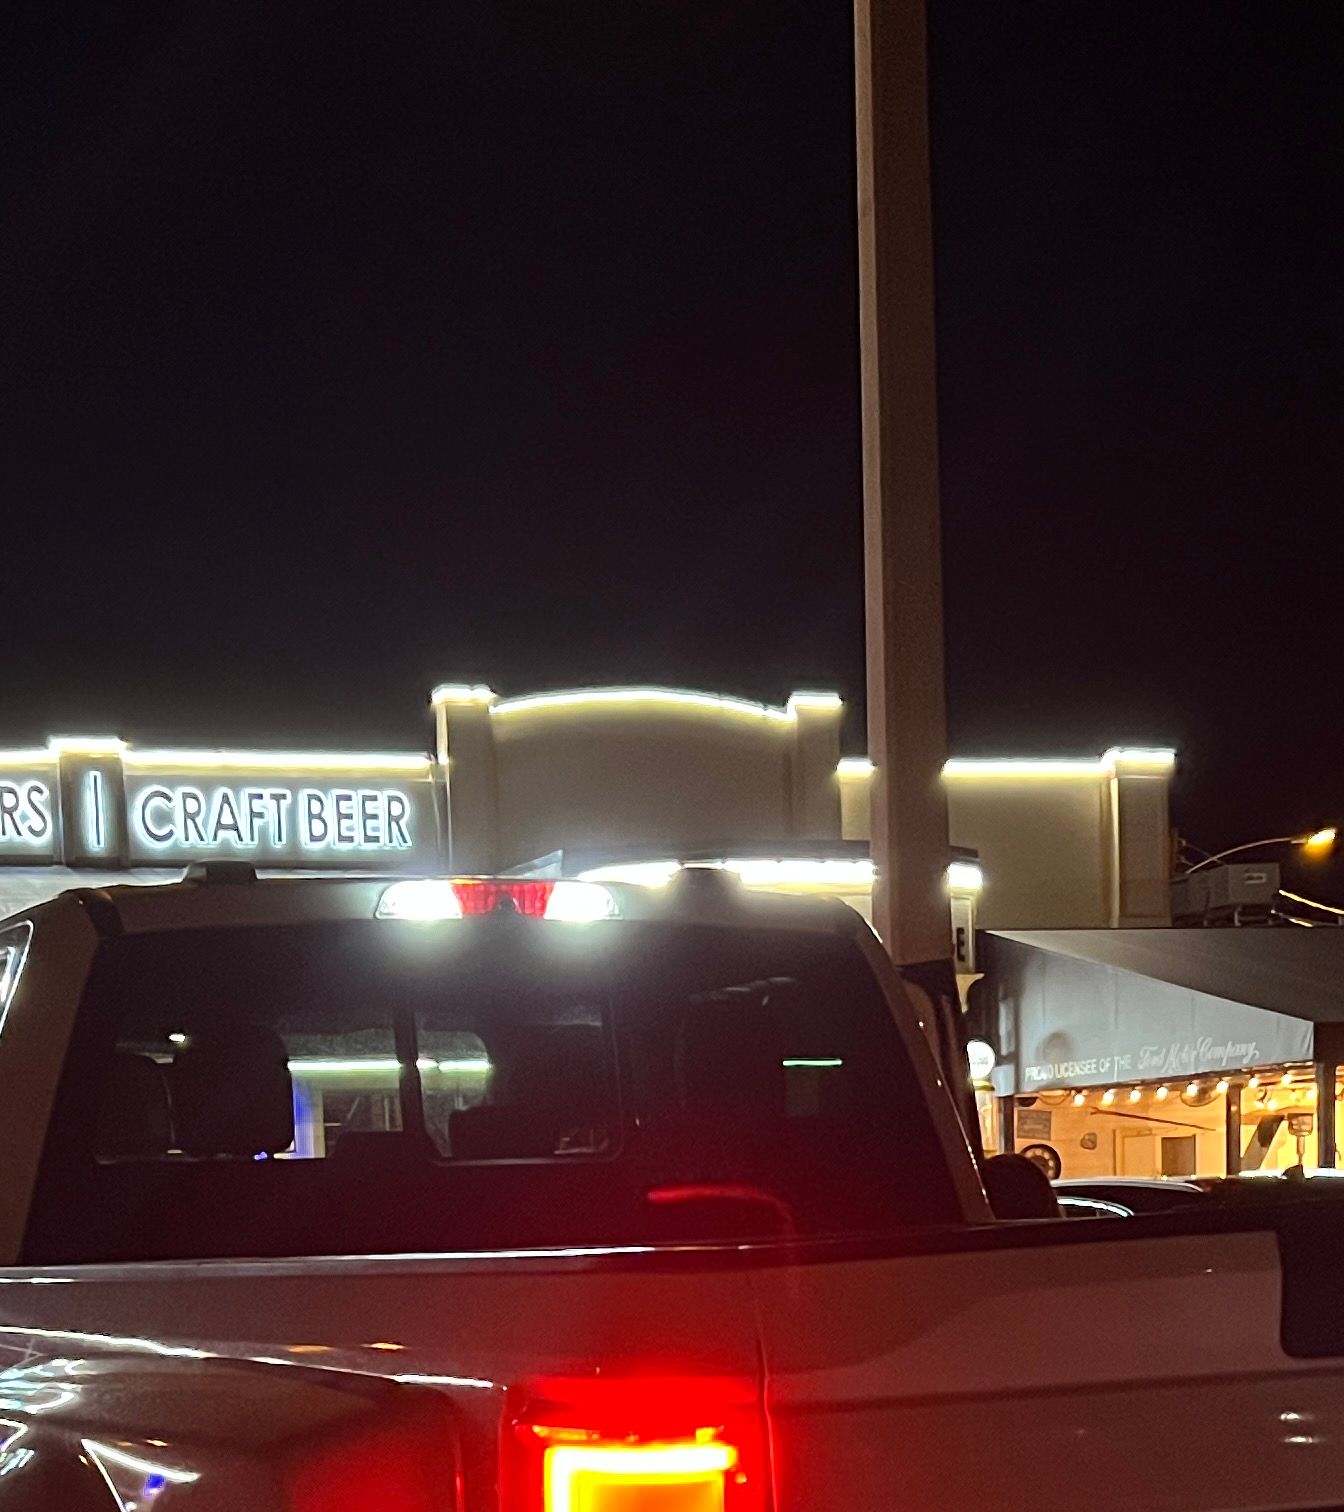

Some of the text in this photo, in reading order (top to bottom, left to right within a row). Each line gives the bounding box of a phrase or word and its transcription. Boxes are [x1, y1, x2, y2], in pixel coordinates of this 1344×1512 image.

[137, 786, 412, 847] CRAFT BEER
[1054, 1059, 1098, 1080] LICENSEE
[1099, 1057, 1112, 1073] OF
[1195, 1036, 1260, 1065] Company
